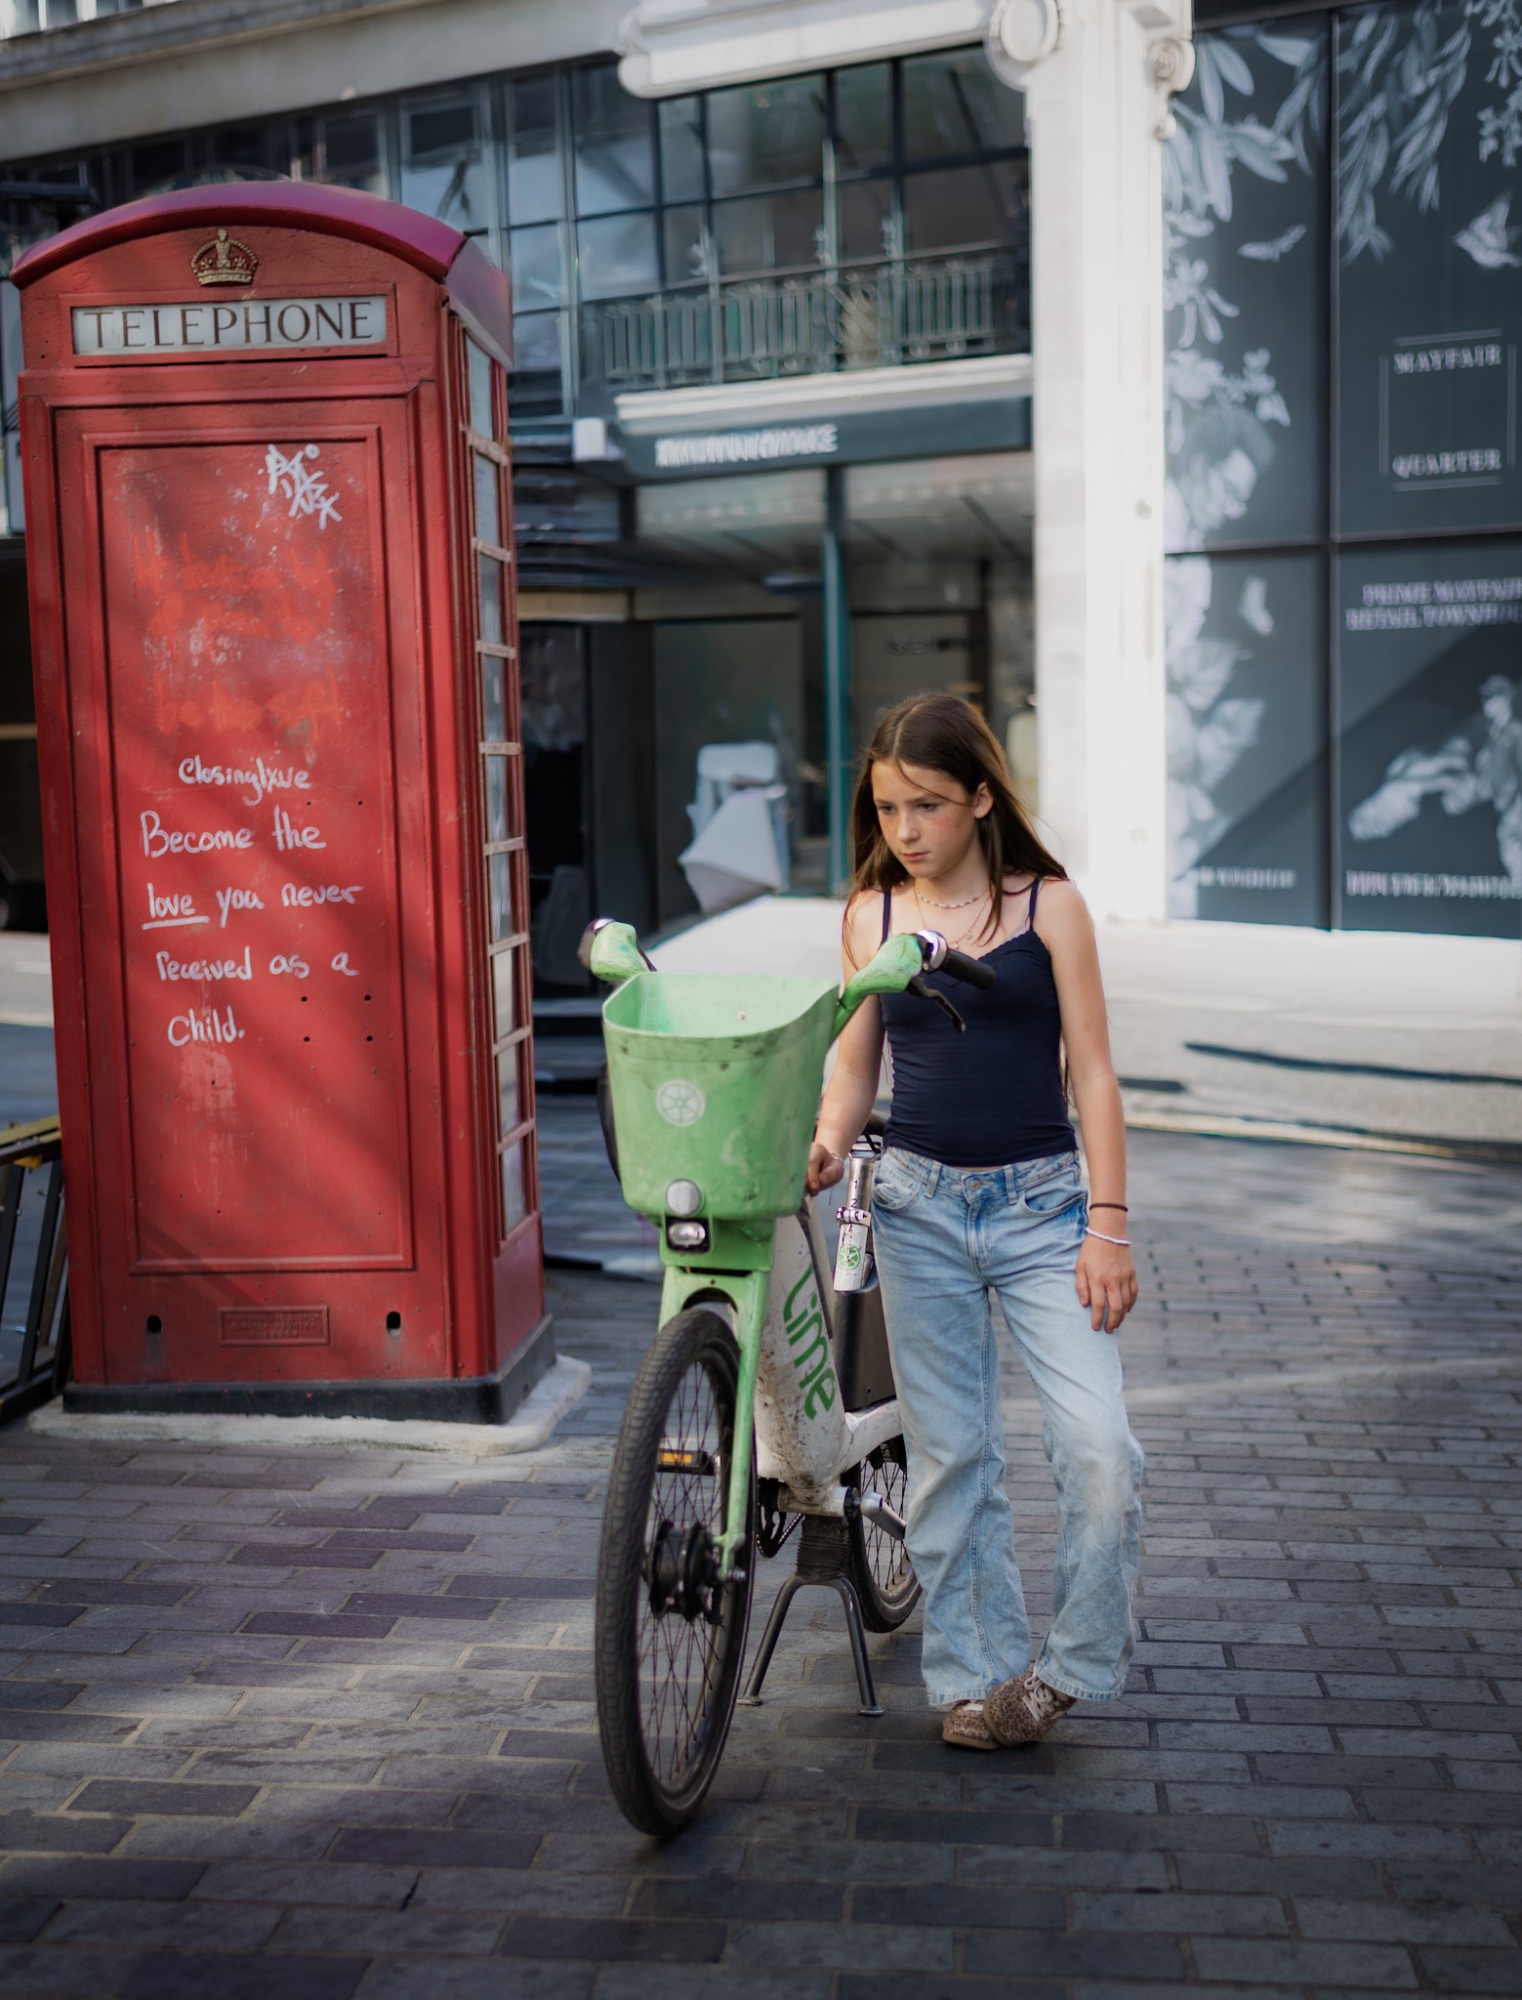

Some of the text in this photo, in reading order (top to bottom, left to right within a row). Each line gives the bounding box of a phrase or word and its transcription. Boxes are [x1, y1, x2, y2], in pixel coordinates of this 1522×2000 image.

[83, 301, 373, 349] TELEPHONE
[1393, 343, 1502, 375] MAYFAIR
[1391, 448, 1502, 479] QUARTER
[140, 804, 327, 859] Become the
[146, 882, 364, 929] love you never
[269, 954, 310, 979] as
[331, 951, 360, 976] a
[167, 1004, 246, 1047] Child.
